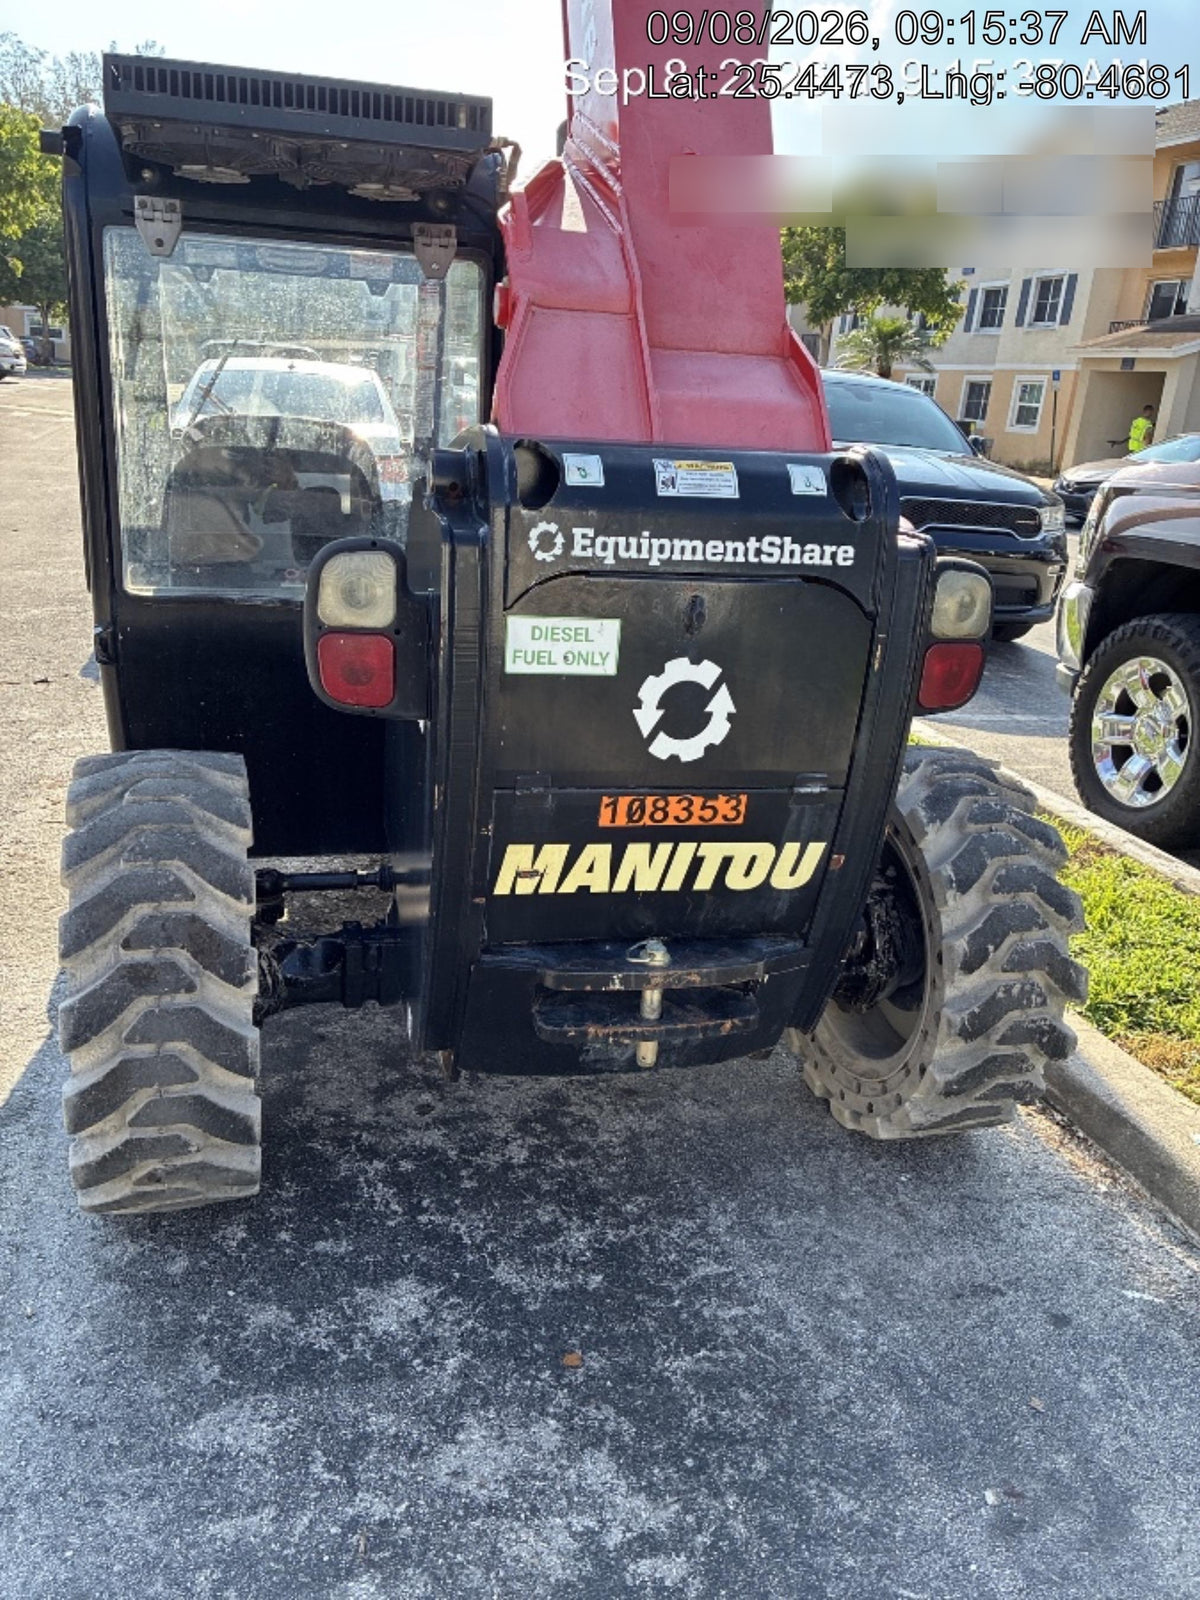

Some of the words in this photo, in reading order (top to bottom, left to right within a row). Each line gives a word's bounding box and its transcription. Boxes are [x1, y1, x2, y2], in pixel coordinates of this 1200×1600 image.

[570, 527, 855, 567] EquipmentShare
[531, 625, 594, 643] DIESEL
[512, 649, 557, 666] FUEL
[563, 650, 610, 667] ONLY
[603, 794, 744, 826] 108353
[493, 841, 827, 895] MANITOU
